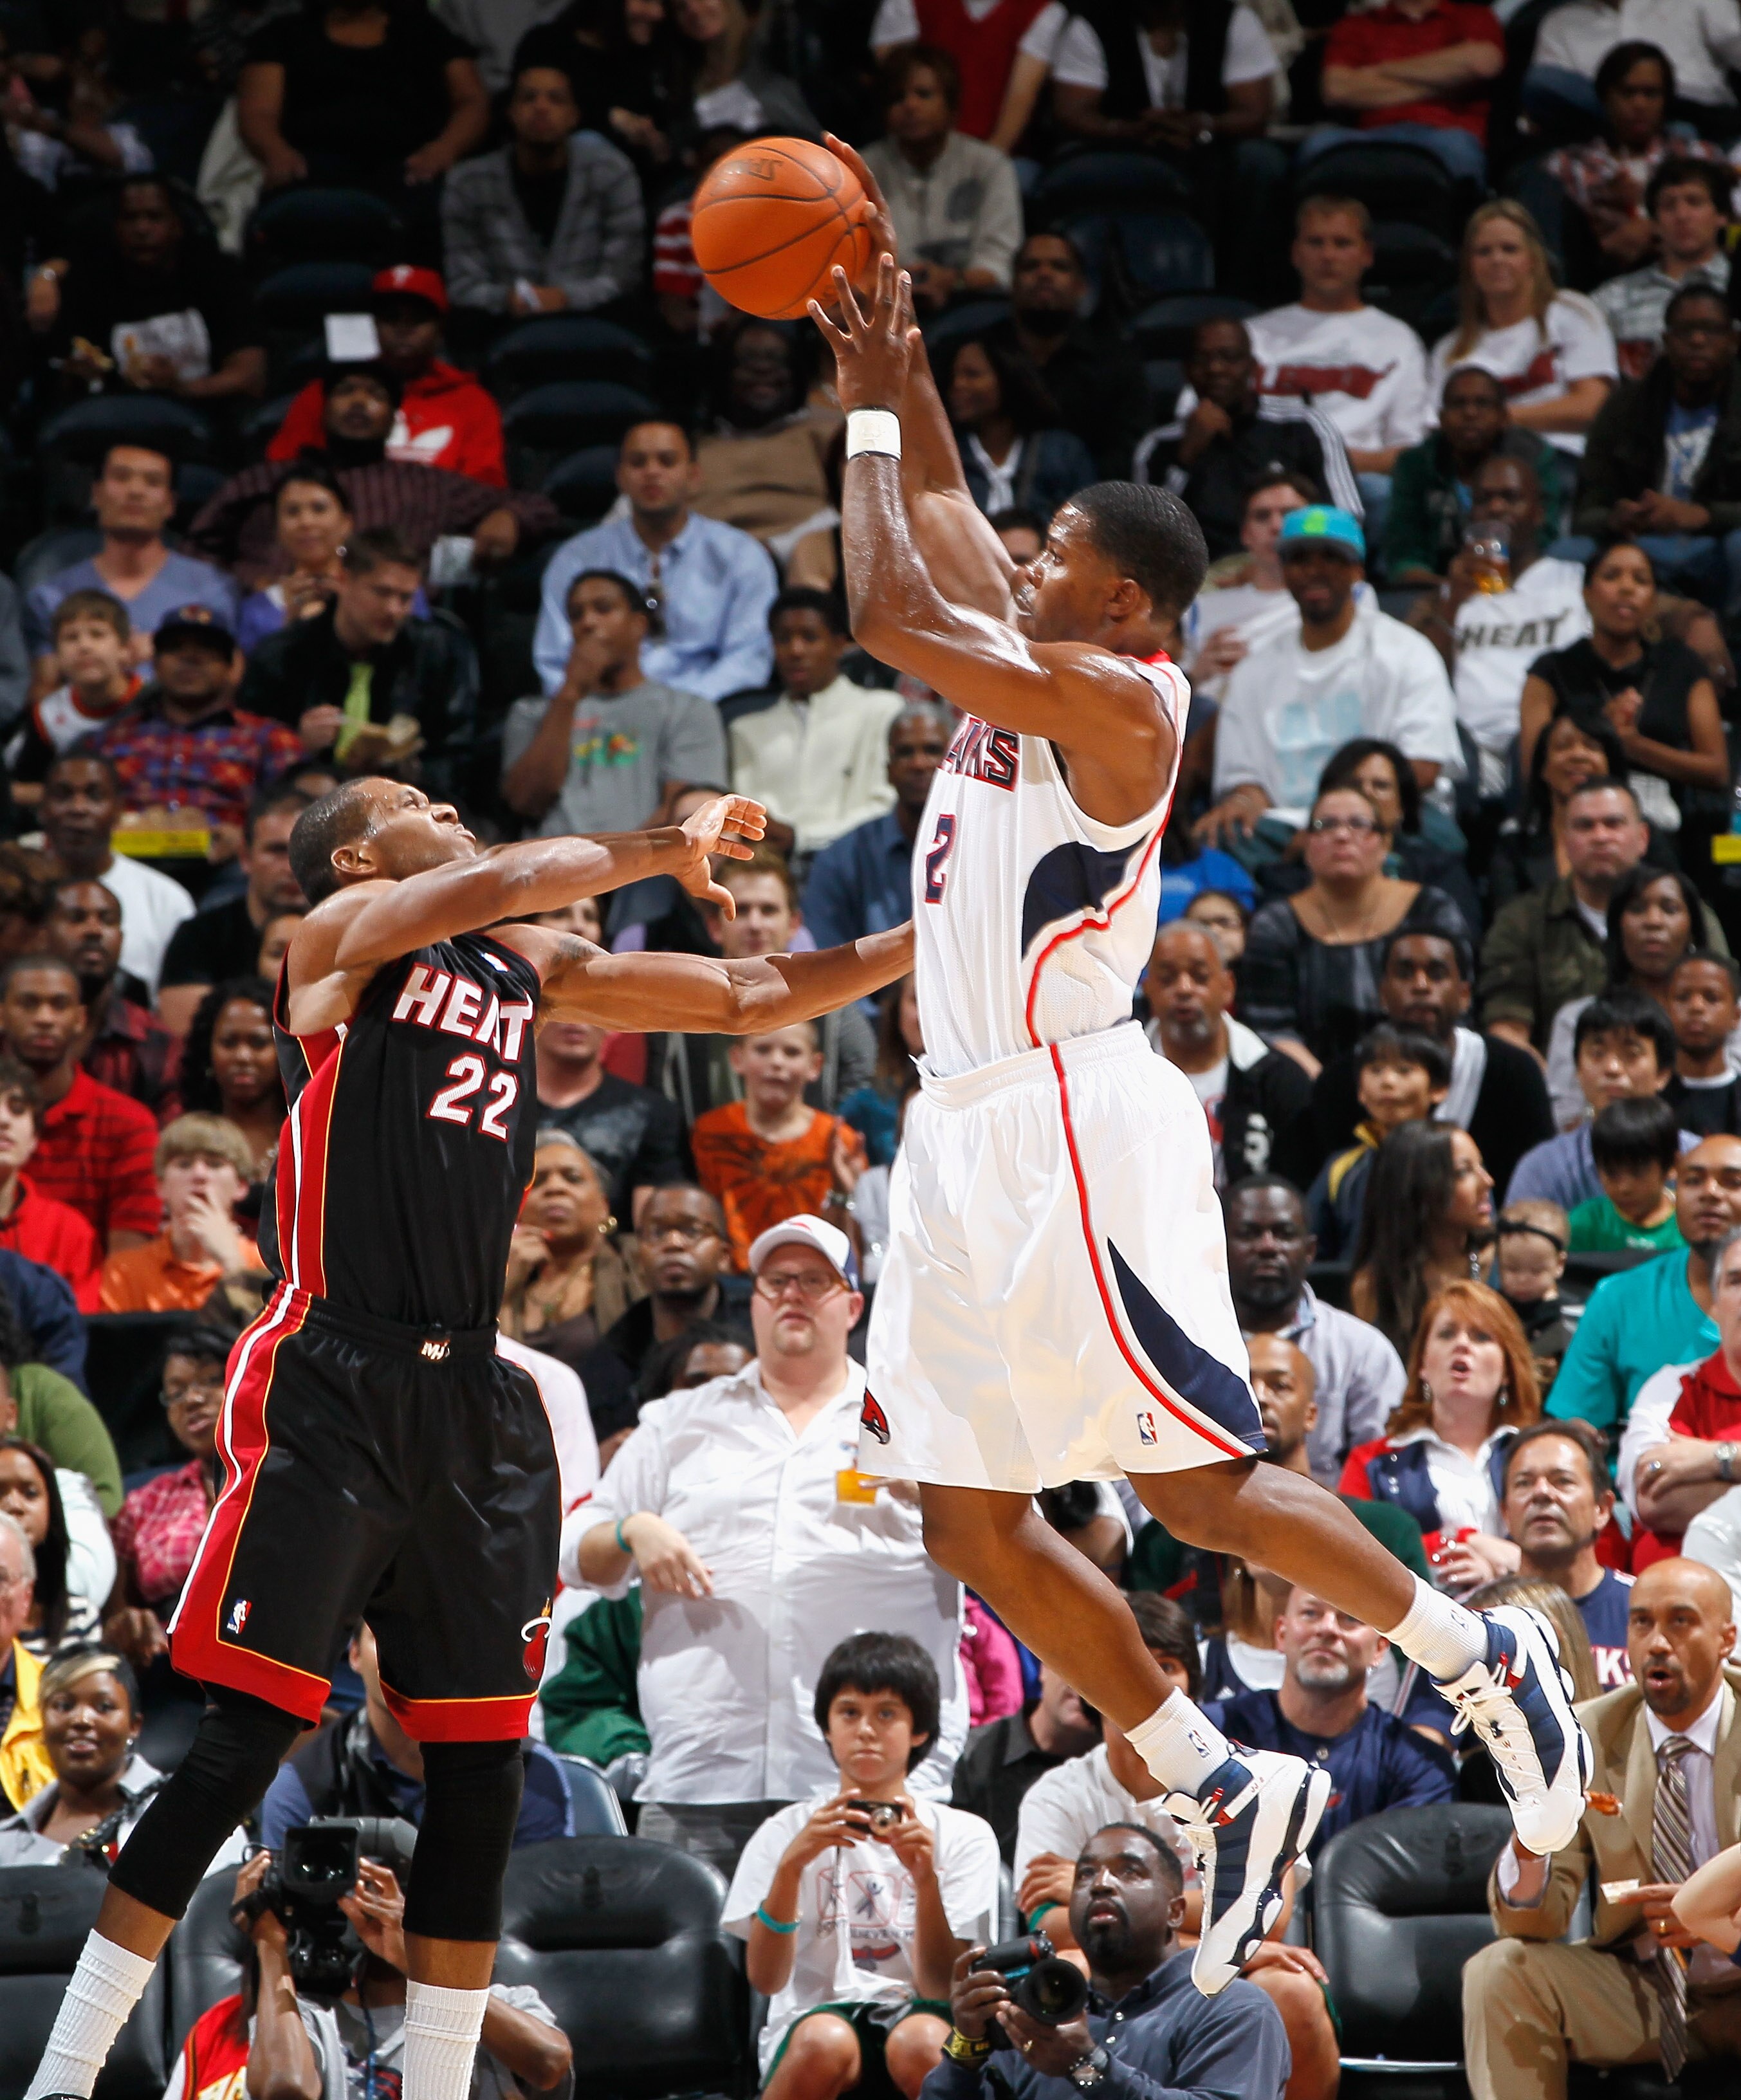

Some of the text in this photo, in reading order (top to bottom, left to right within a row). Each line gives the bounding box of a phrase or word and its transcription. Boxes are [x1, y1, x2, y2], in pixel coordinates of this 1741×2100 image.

[1460, 606, 1574, 651] HEAT
[925, 813, 957, 904] 2
[391, 963, 535, 1062] HEAT
[425, 1052, 519, 1143] 22
